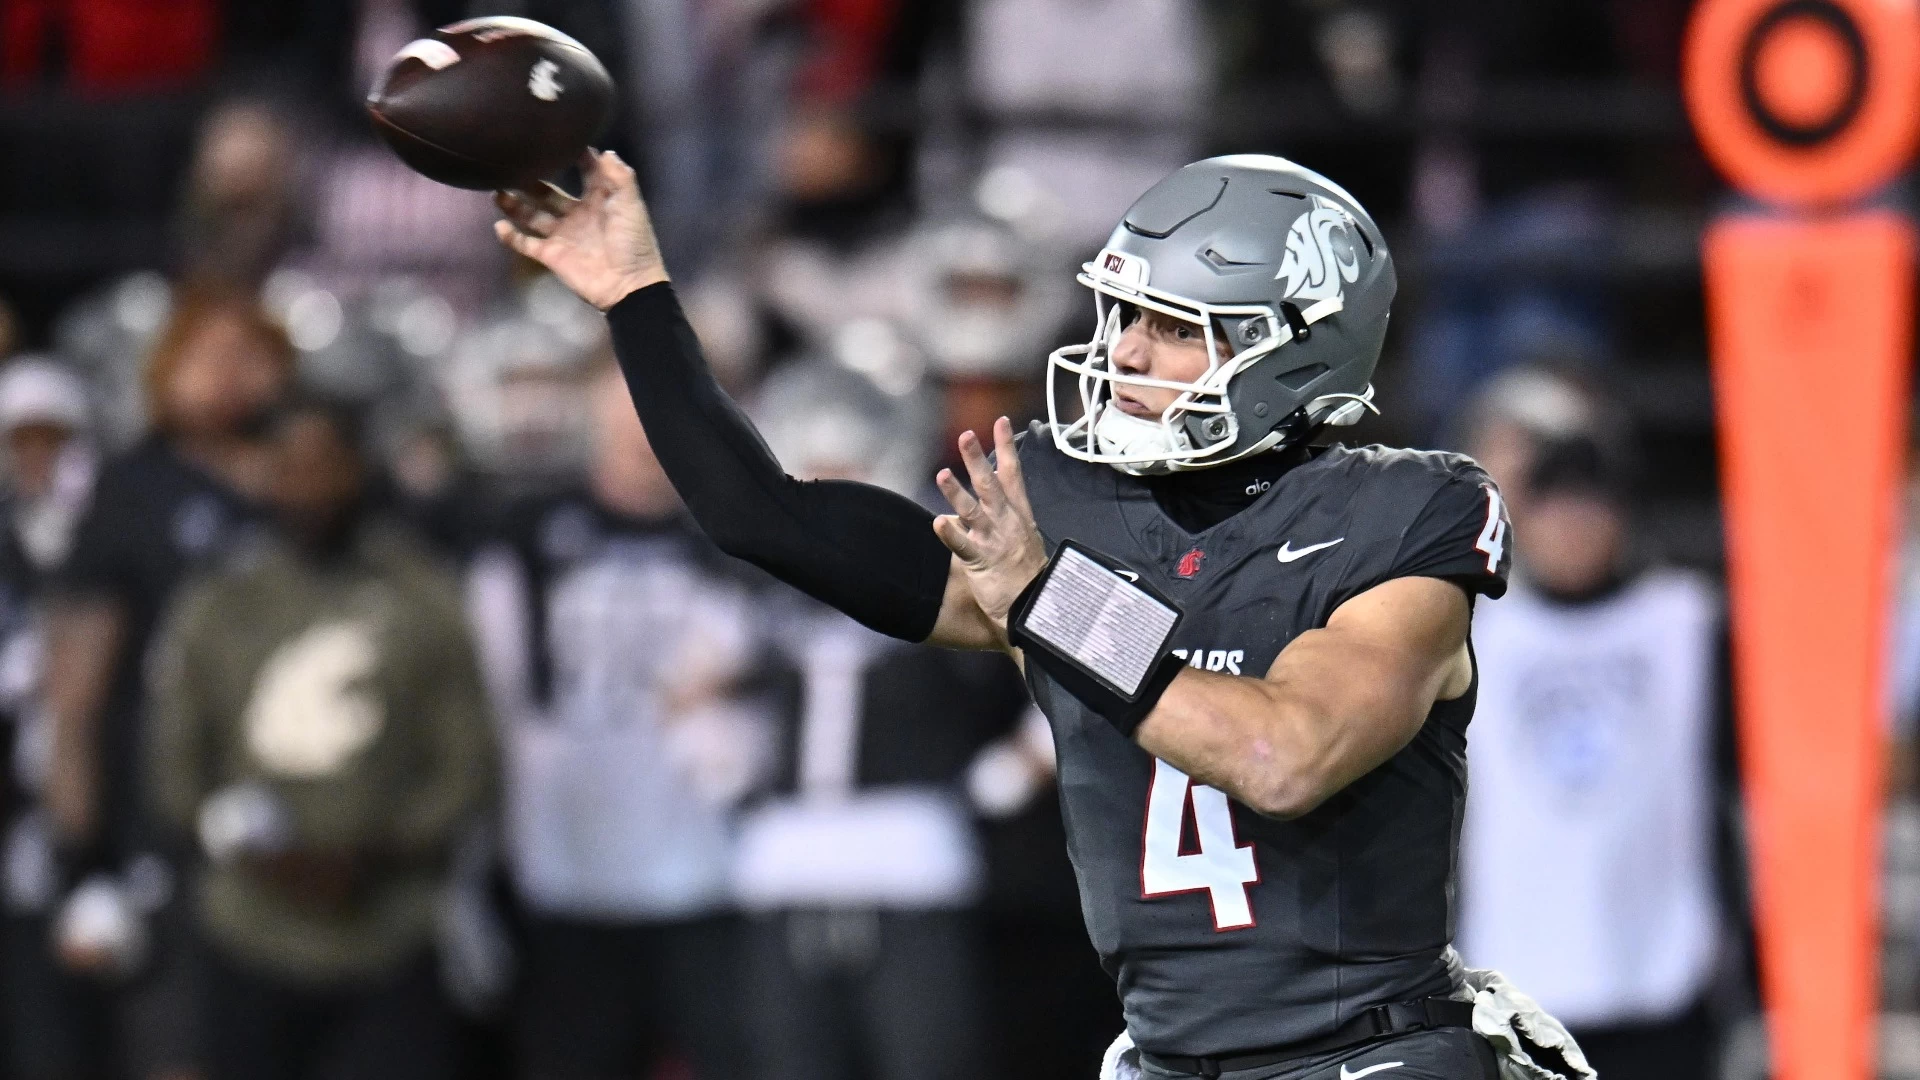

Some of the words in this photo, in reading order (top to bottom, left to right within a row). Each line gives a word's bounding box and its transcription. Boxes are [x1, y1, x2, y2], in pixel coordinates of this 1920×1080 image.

[1103, 253, 1126, 275] WSU
[1245, 478, 1271, 496] alo
[1472, 485, 1506, 576] 4
[1140, 754, 1262, 933] 4
